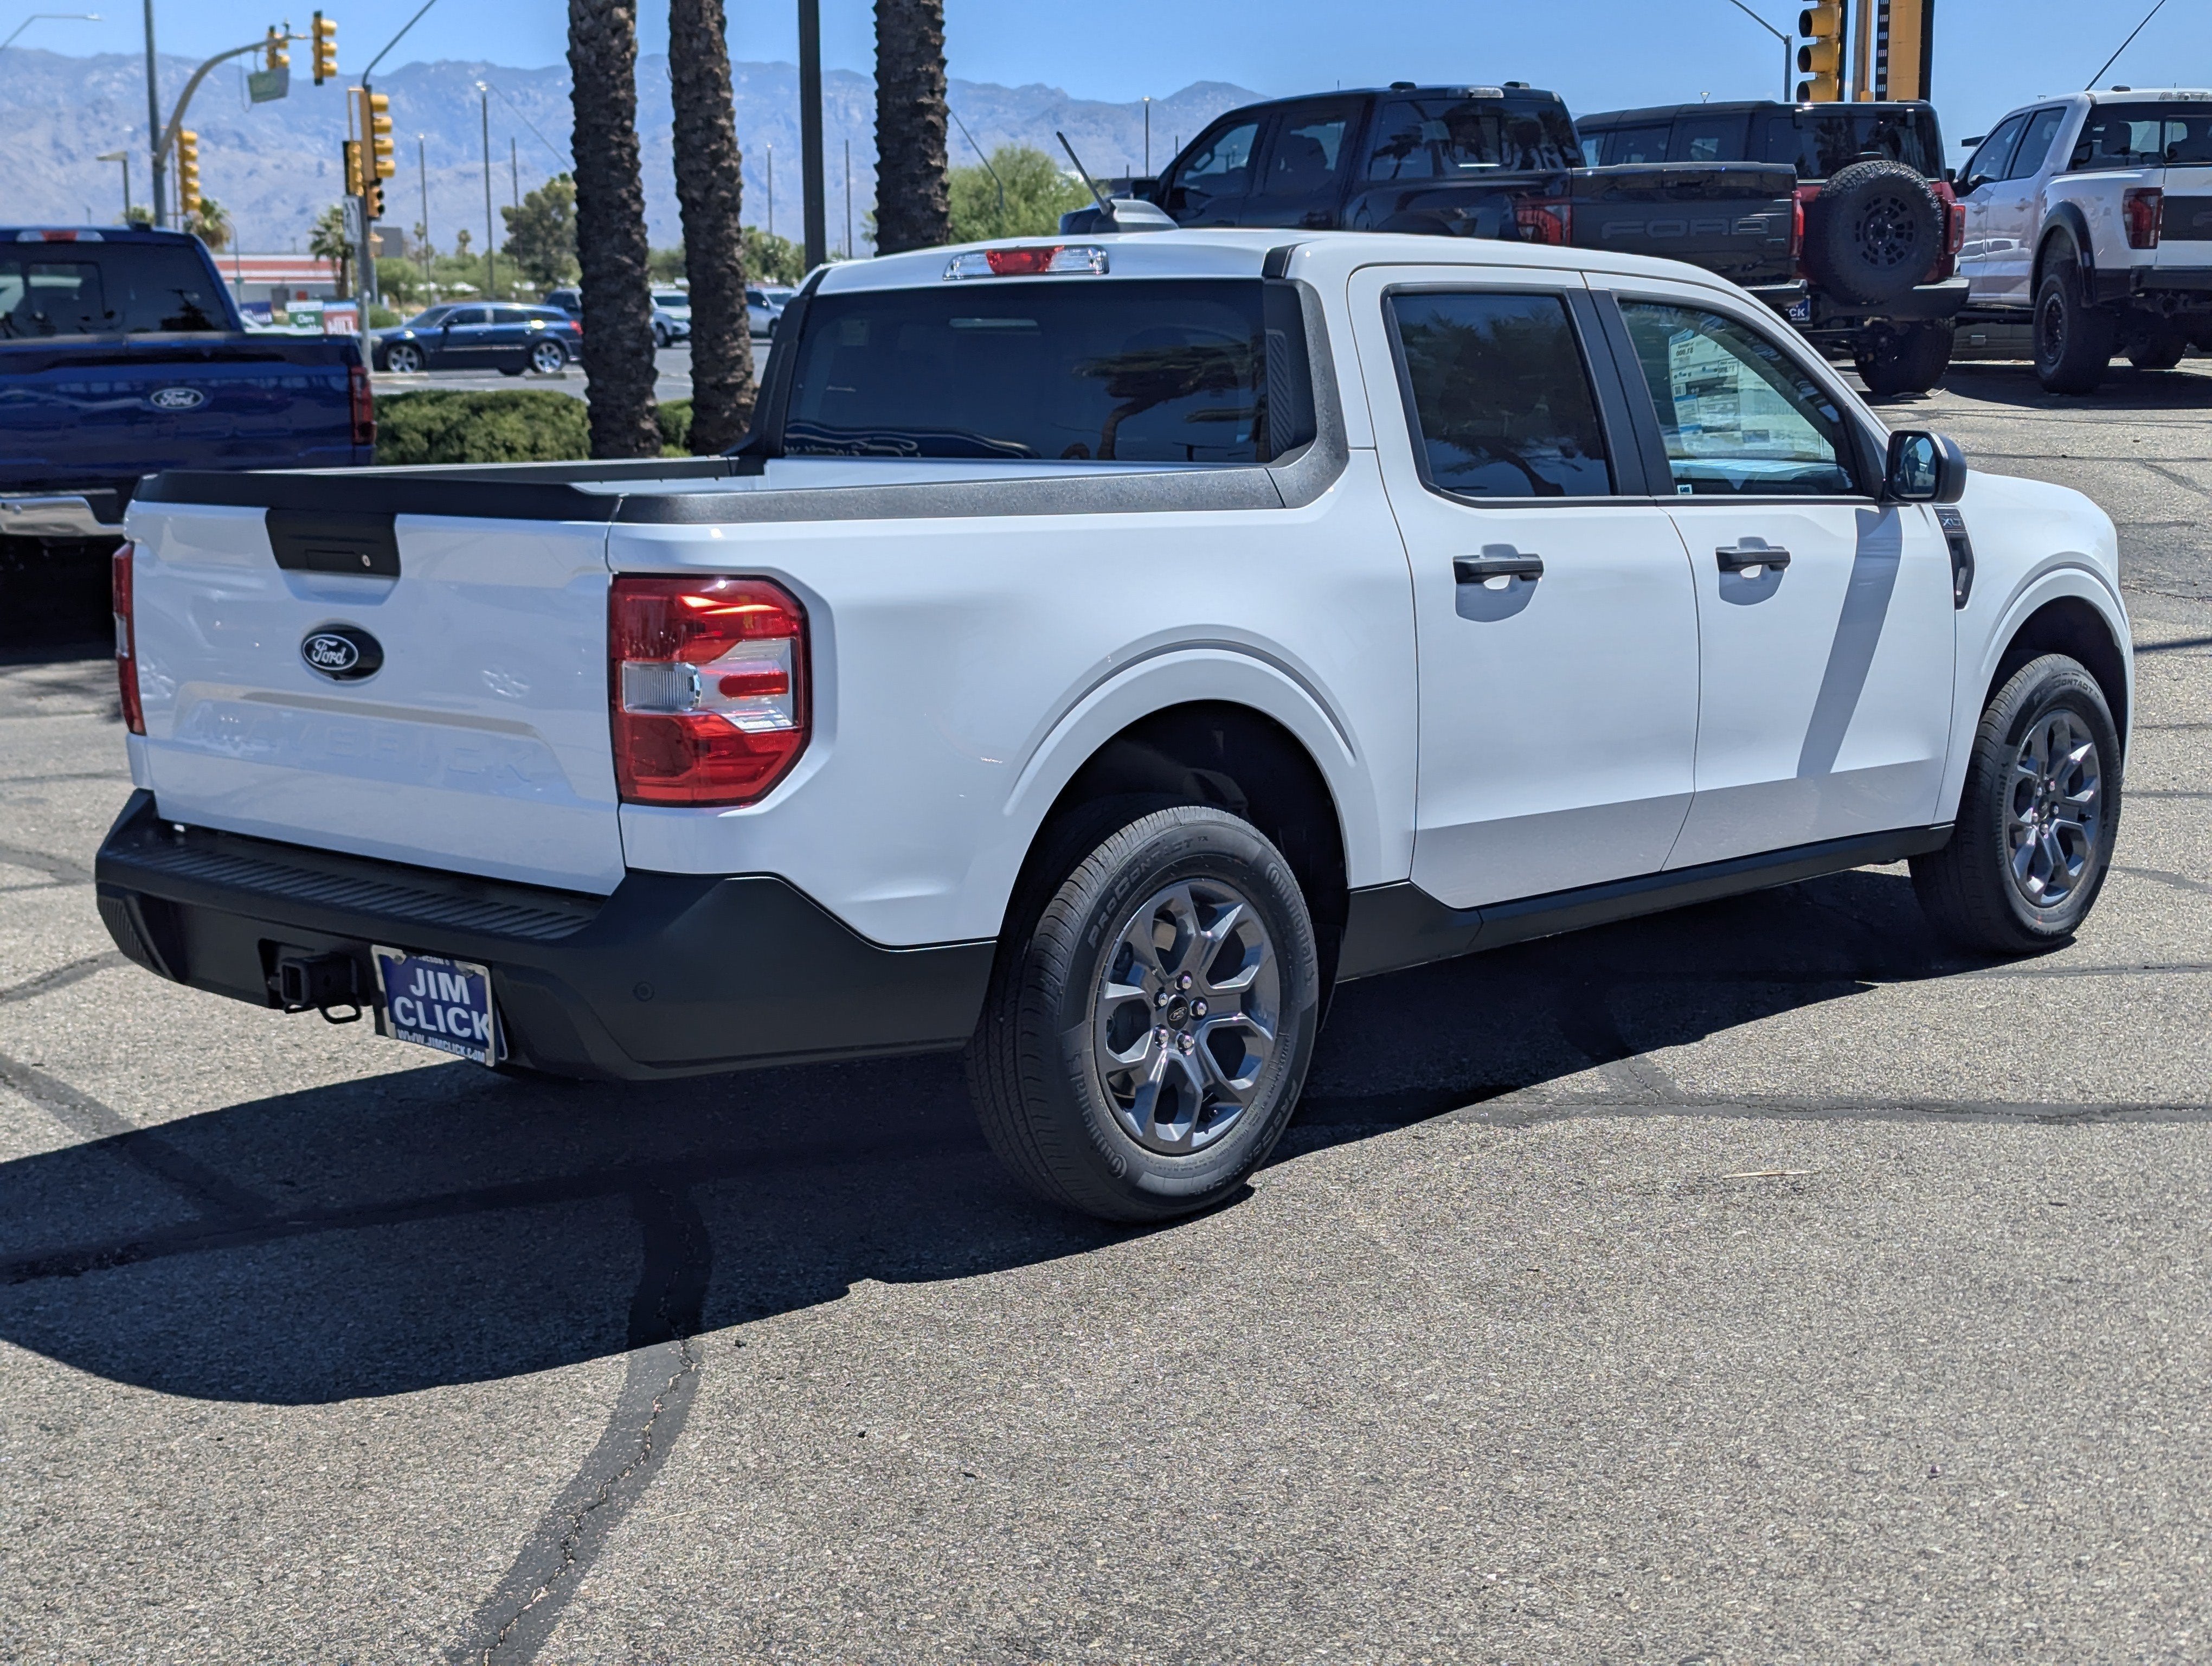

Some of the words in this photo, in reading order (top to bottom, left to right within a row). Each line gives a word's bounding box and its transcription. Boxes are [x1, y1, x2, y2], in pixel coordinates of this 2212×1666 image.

[1601, 218, 1770, 239] FORD
[159, 391, 194, 406] Ford
[312, 639, 346, 664] Ford
[190, 707, 536, 783] VERICK
[410, 967, 471, 1005] JIM
[394, 996, 490, 1040] CLICK
